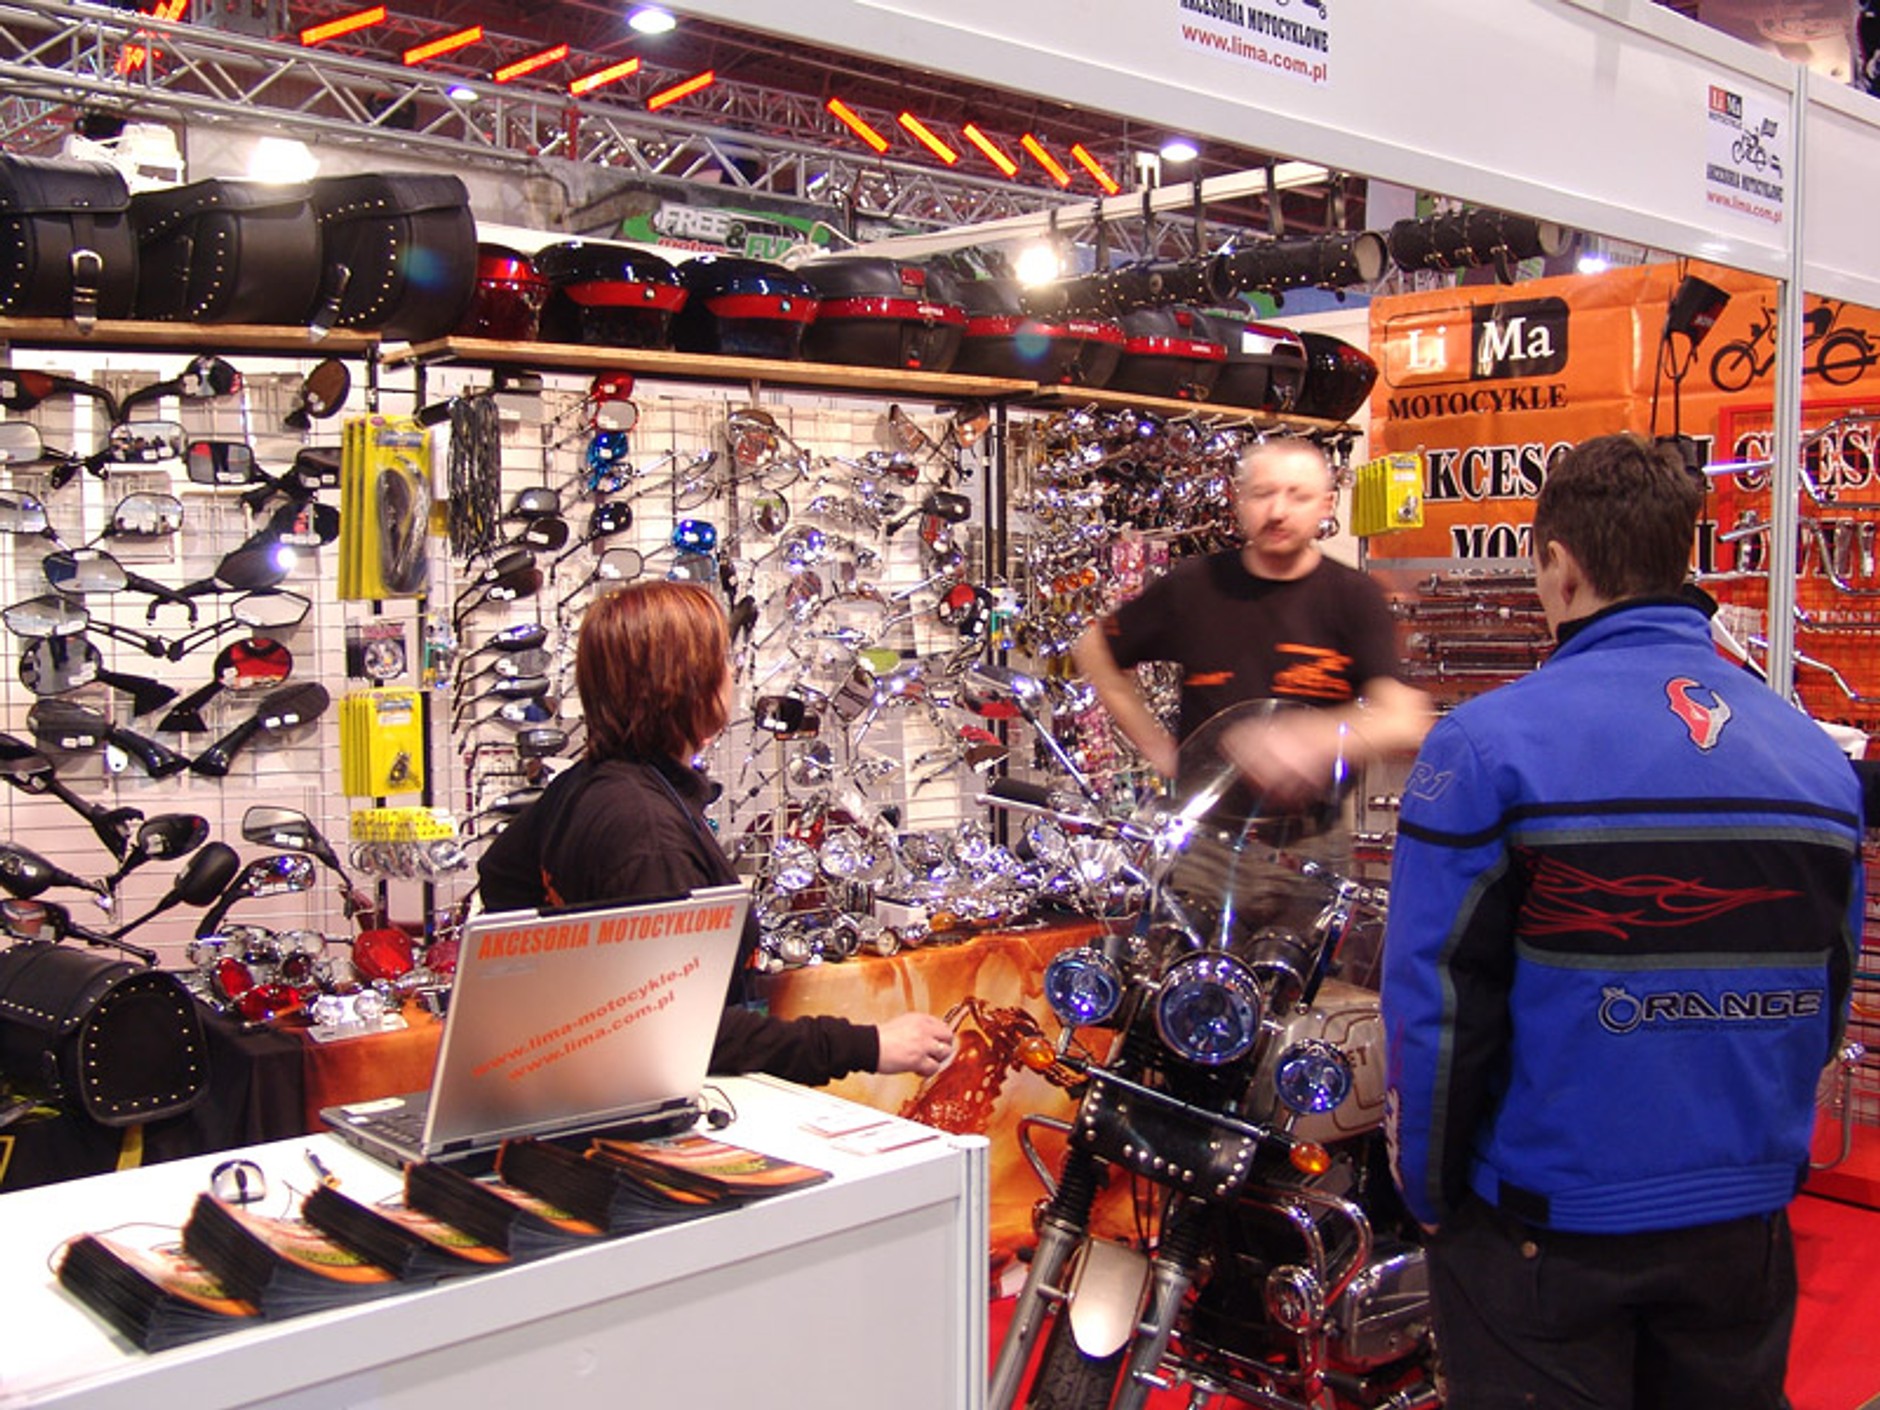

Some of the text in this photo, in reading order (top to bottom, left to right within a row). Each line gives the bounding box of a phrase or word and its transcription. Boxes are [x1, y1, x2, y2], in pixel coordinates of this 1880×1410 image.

[1182, 25, 1327, 82] www.lima.com.pl
[1247, 7, 1329, 53] MOTOCYKLOWE
[660, 203, 732, 243] FREE
[1386, 383, 1568, 422] MOTOCYKLE
[477, 905, 737, 961] AKCESORIA MOTOCYKLOWE
[471, 957, 701, 1080] www.lima-motocykle.pl
[507, 990, 676, 1082] www.lima.com.pl
[1598, 986, 1825, 1034] ORANGE
